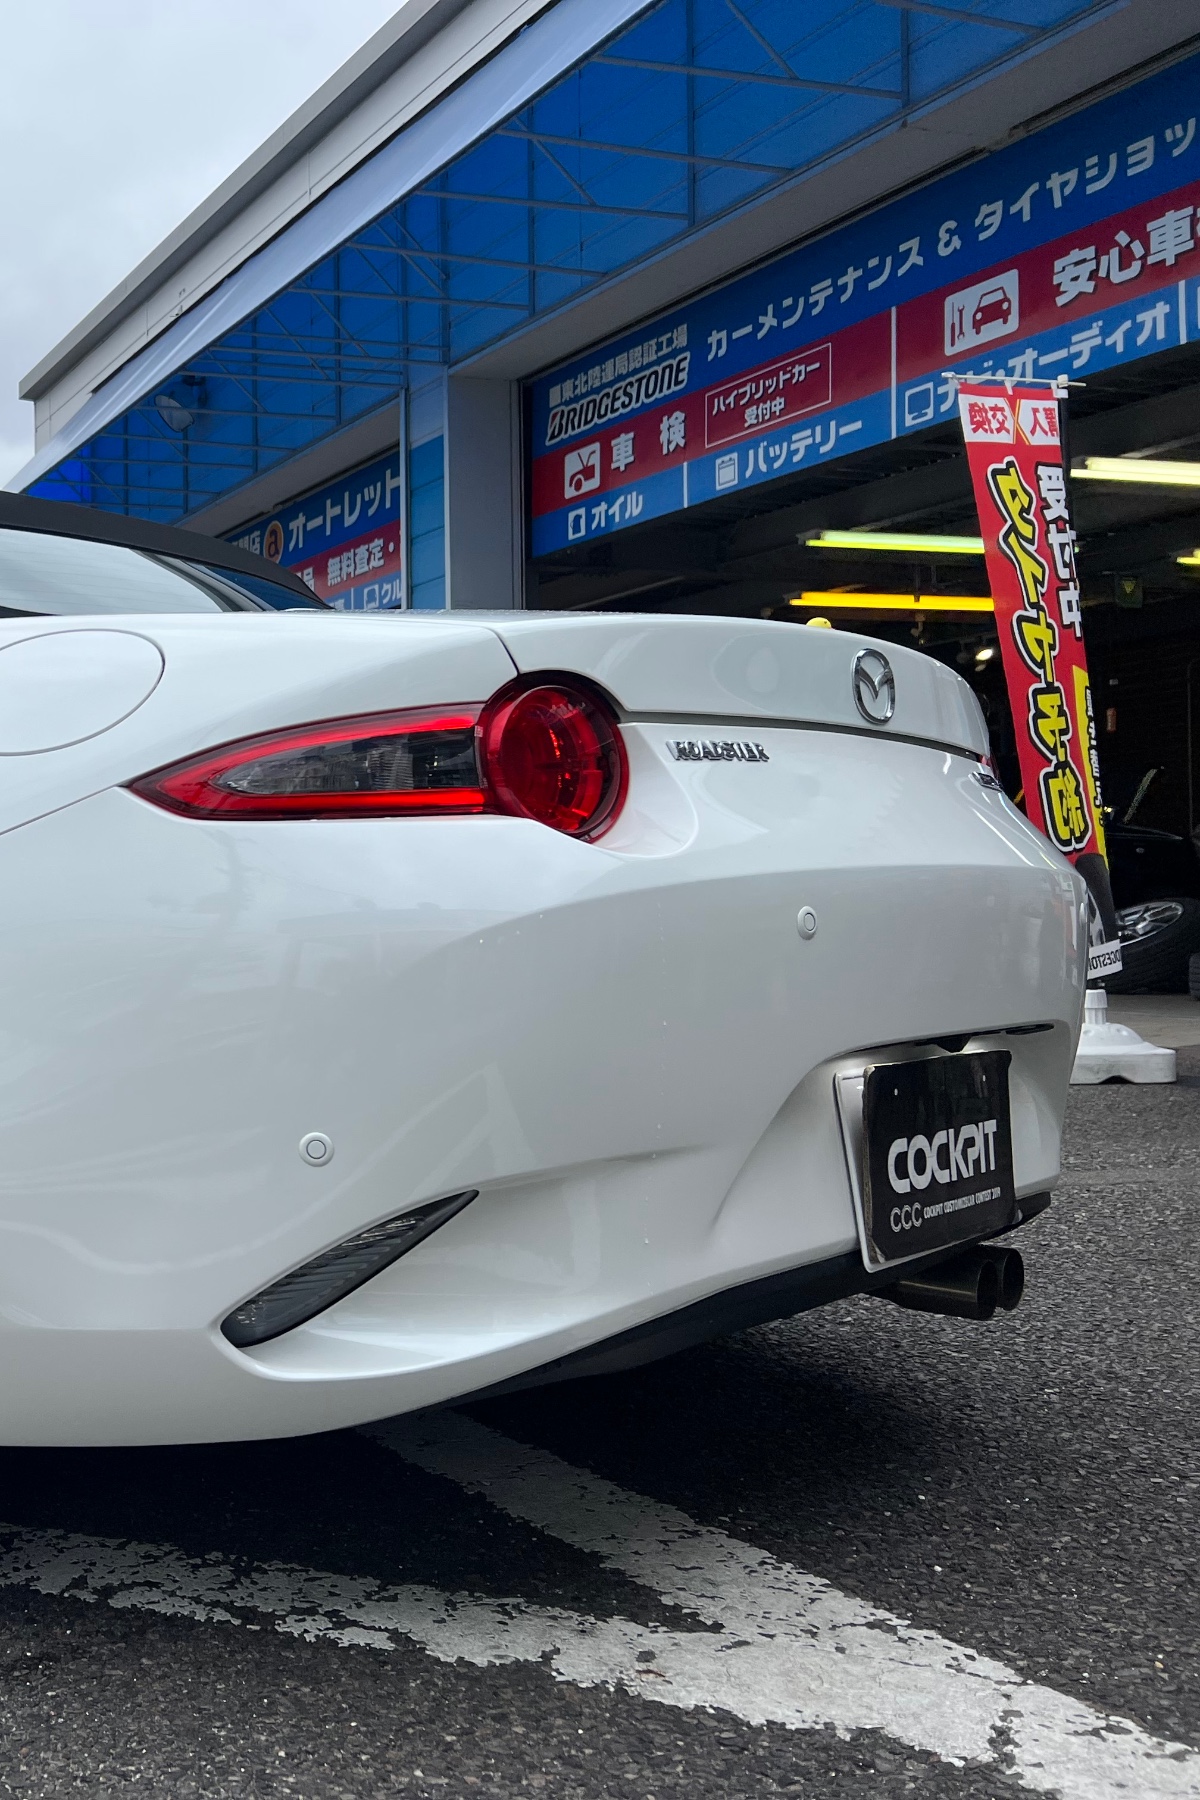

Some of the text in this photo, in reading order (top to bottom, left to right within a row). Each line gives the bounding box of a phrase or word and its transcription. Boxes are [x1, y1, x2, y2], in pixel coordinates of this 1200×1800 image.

[1052, 205, 1200, 308] 安心車
[707, 236, 924, 362] カーメンテナンス
[937, 219, 962, 257] &
[546, 352, 689, 445] BRIDGESTONE
[712, 362, 821, 416] ハイブリッドカー
[744, 396, 785, 428] 受付中
[745, 420, 862, 479] バッテリー
[591, 490, 643, 531] オイル
[666, 740, 769, 762] ROADSTER
[888, 1119, 997, 1194] COCKPIT
[890, 1202, 922, 1232] CCC
